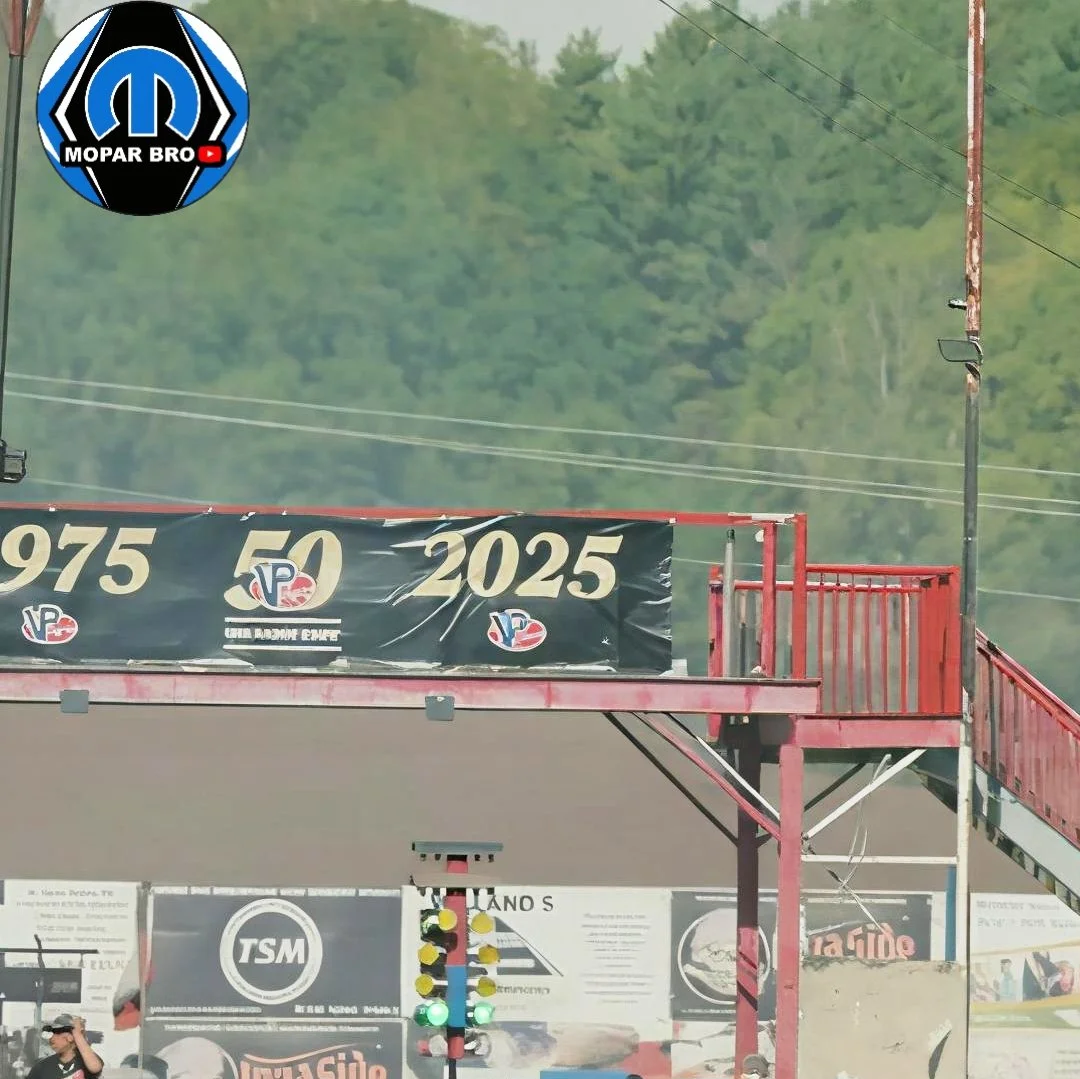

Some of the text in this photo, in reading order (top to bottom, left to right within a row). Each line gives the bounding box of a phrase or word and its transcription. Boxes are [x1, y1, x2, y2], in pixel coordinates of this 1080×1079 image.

[224, 530, 343, 611] 50
[413, 530, 623, 599] 2025
[239, 938, 305, 964] TSM
